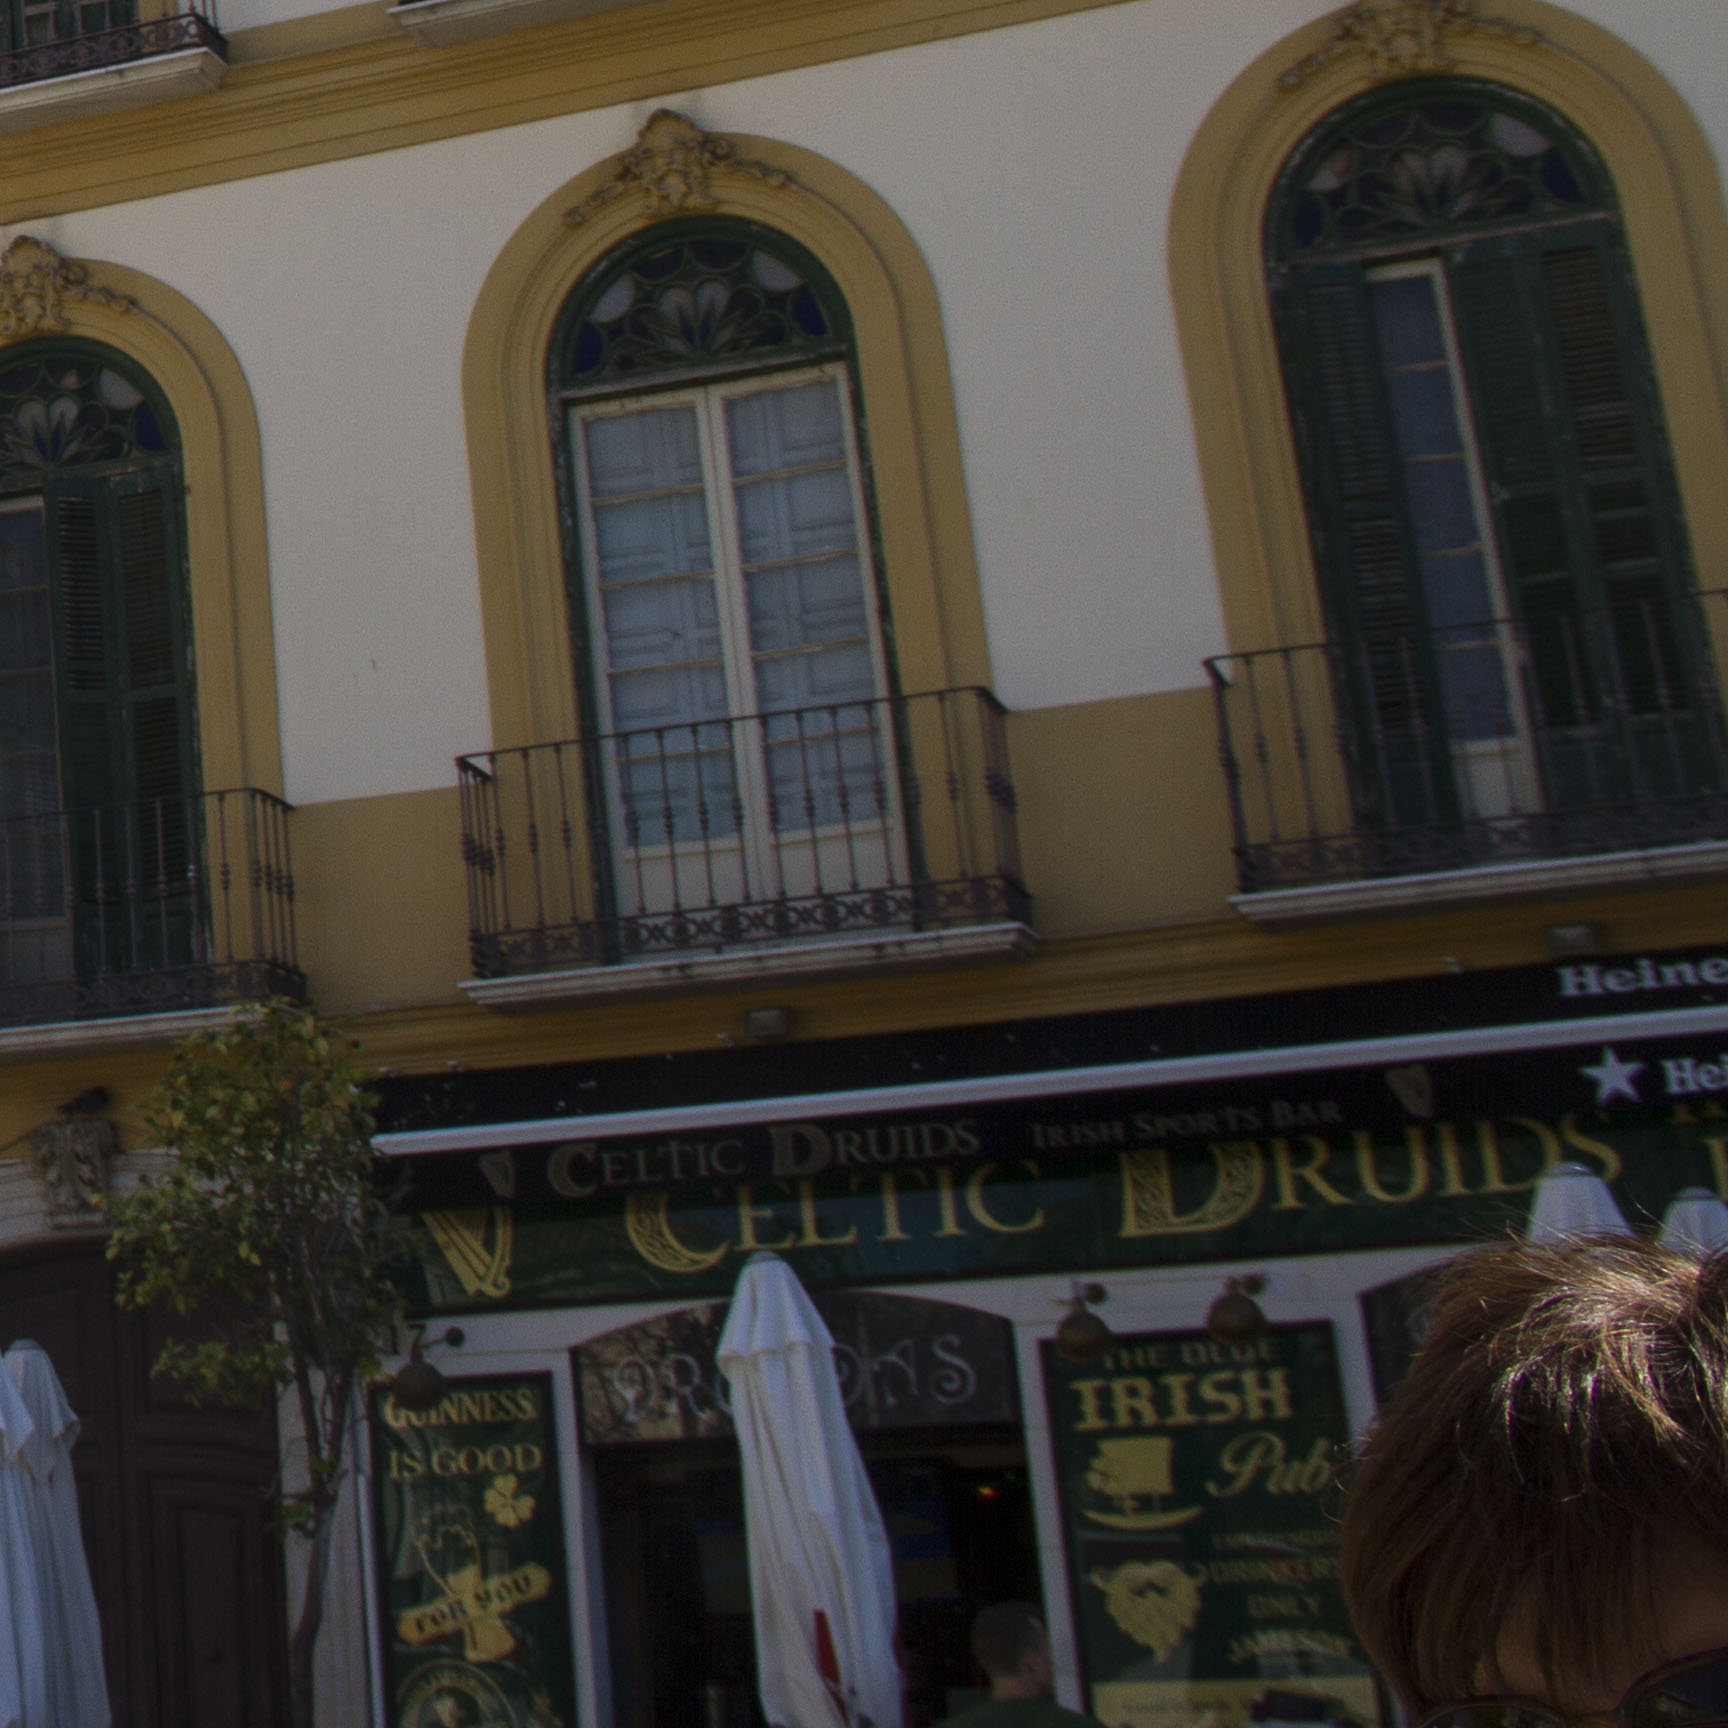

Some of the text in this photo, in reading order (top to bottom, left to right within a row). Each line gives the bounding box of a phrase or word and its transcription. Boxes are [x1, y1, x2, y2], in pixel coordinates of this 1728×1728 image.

[1031, 1098, 1343, 1150] IRISH SPORTS BAR
[547, 1118, 982, 1200] CELTIC DRUIDS
[624, 1158, 1045, 1273] CELTIC
[1068, 1366, 1296, 1431] IRISH
[389, 1443, 542, 1481] IS GOOD
[1204, 1431, 1333, 1499] Pub
[415, 1573, 532, 1634] FOR YOU
